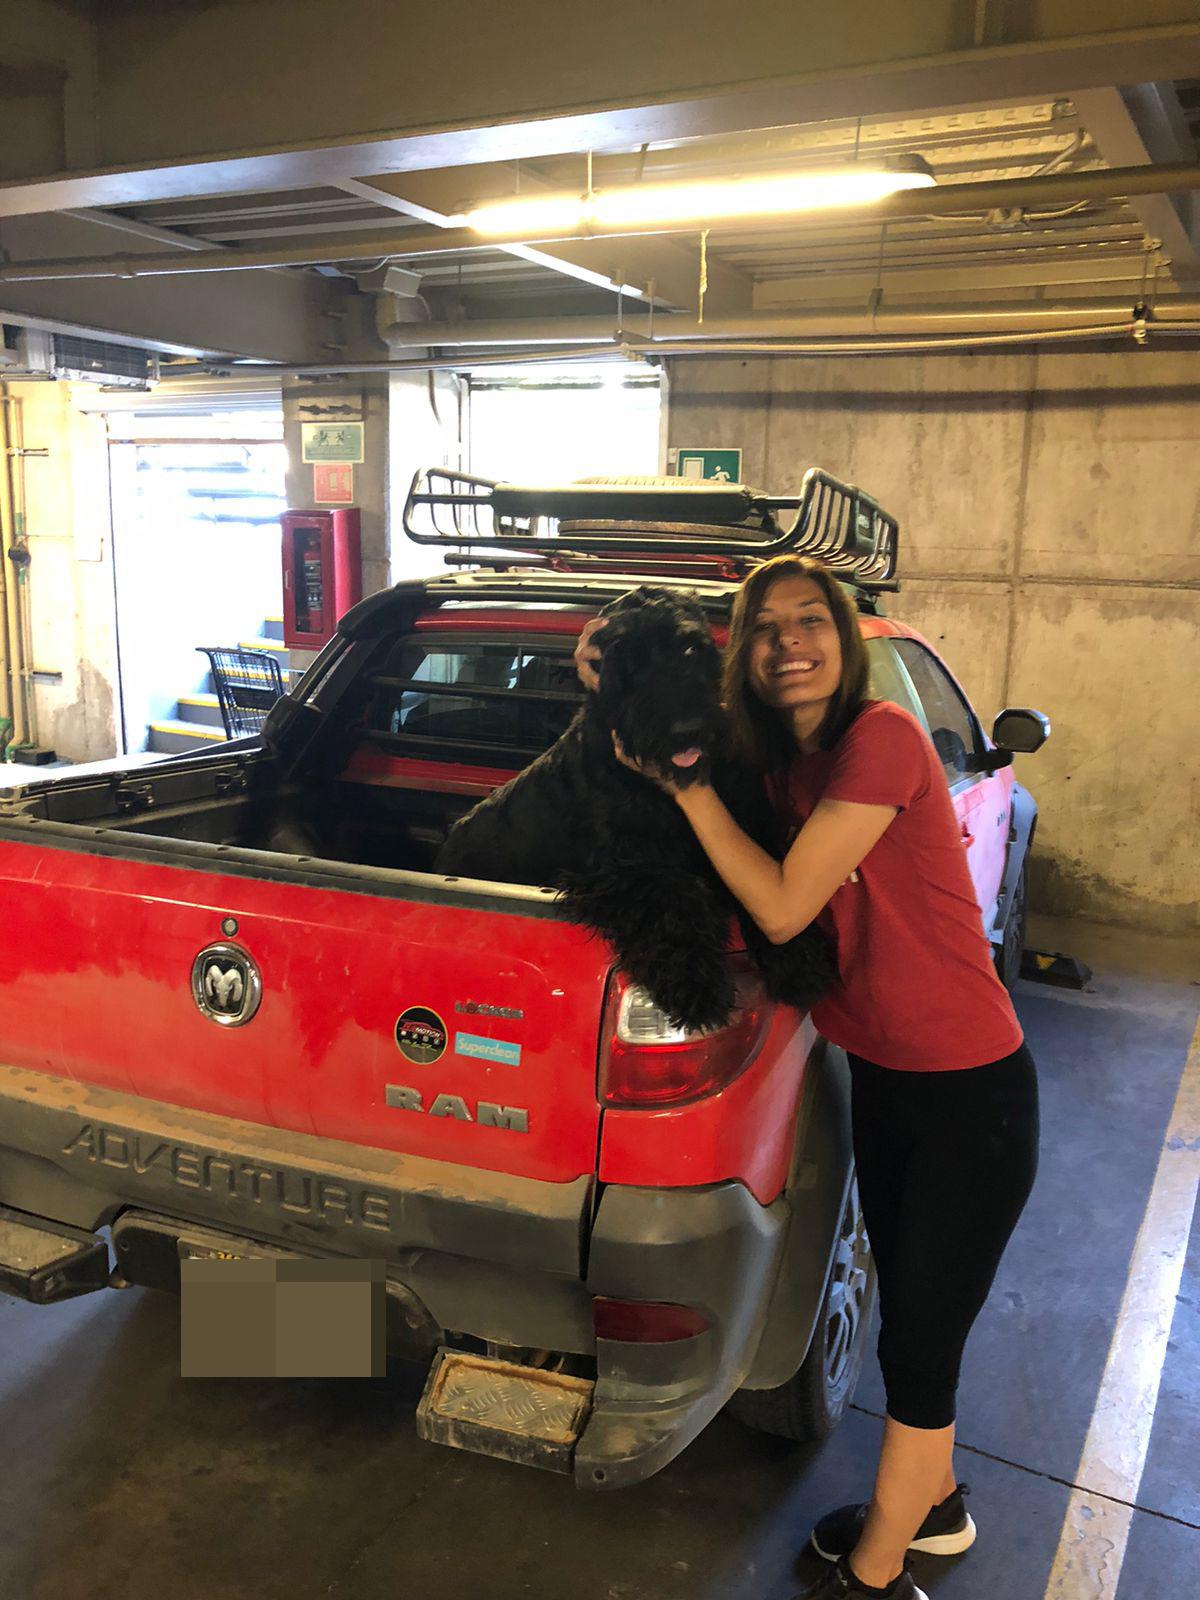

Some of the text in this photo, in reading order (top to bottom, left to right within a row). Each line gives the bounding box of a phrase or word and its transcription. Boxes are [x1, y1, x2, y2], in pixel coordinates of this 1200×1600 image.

[459, 1038, 520, 1059] Superclean
[384, 1083, 529, 1133] RAM
[62, 1124, 391, 1232] ADVENTURE
